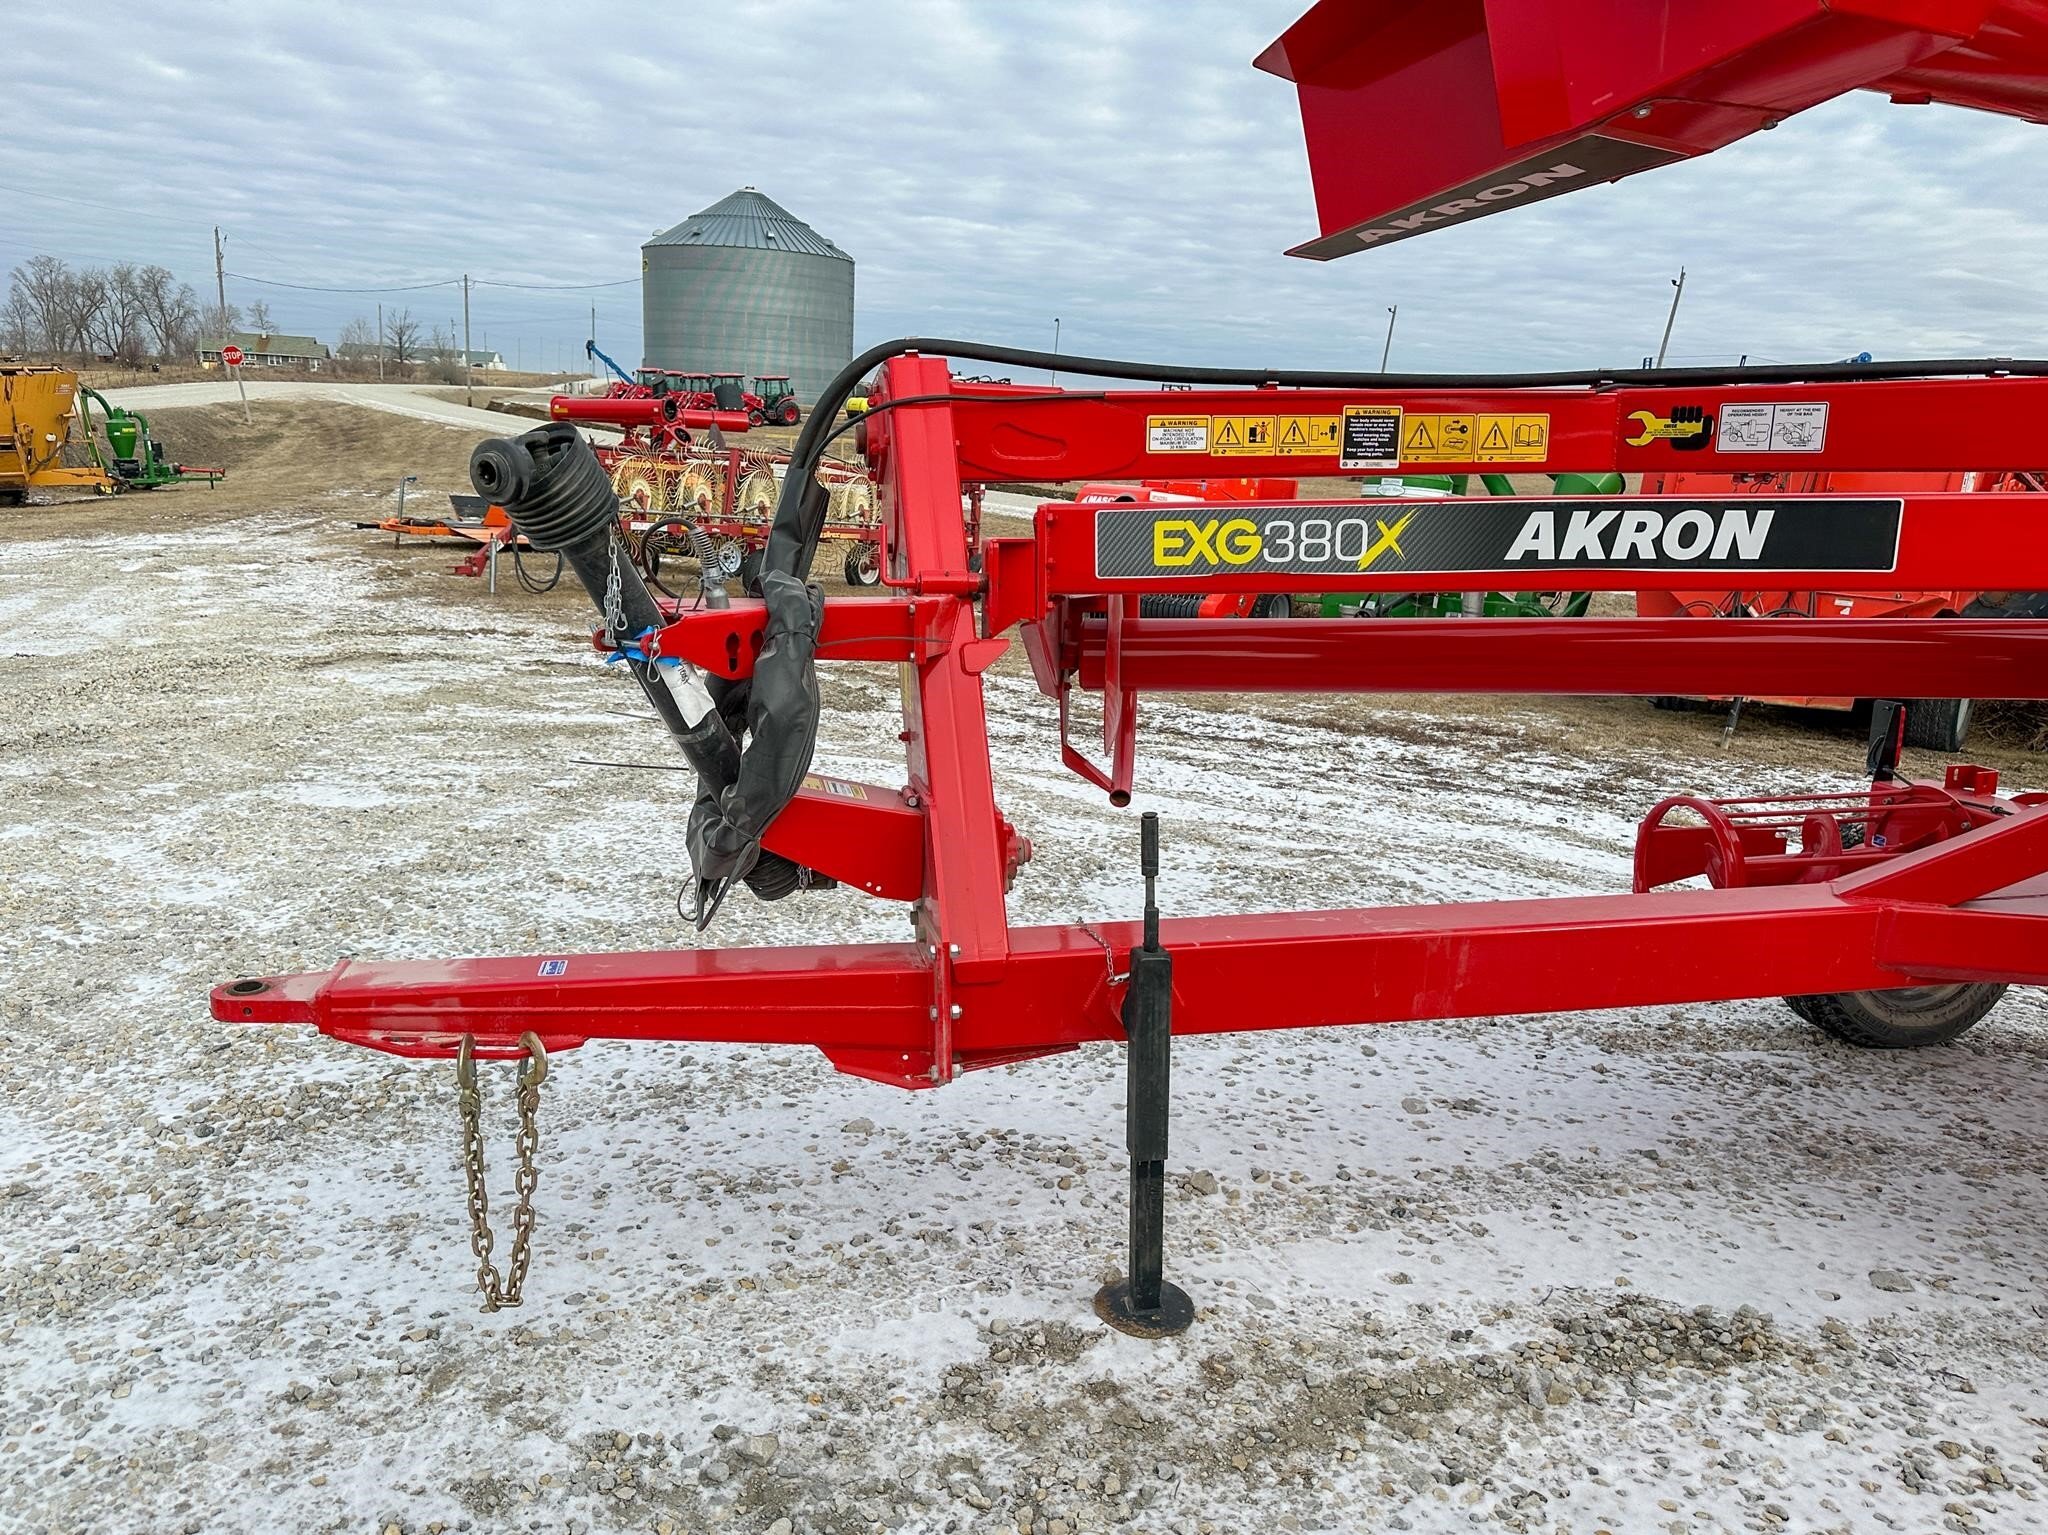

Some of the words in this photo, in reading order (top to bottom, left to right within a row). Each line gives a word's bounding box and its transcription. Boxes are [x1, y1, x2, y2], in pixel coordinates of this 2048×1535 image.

[1356, 163, 1586, 243] AKRON
[223, 351, 242, 360] STOP
[1504, 510, 1775, 560] AKRON
